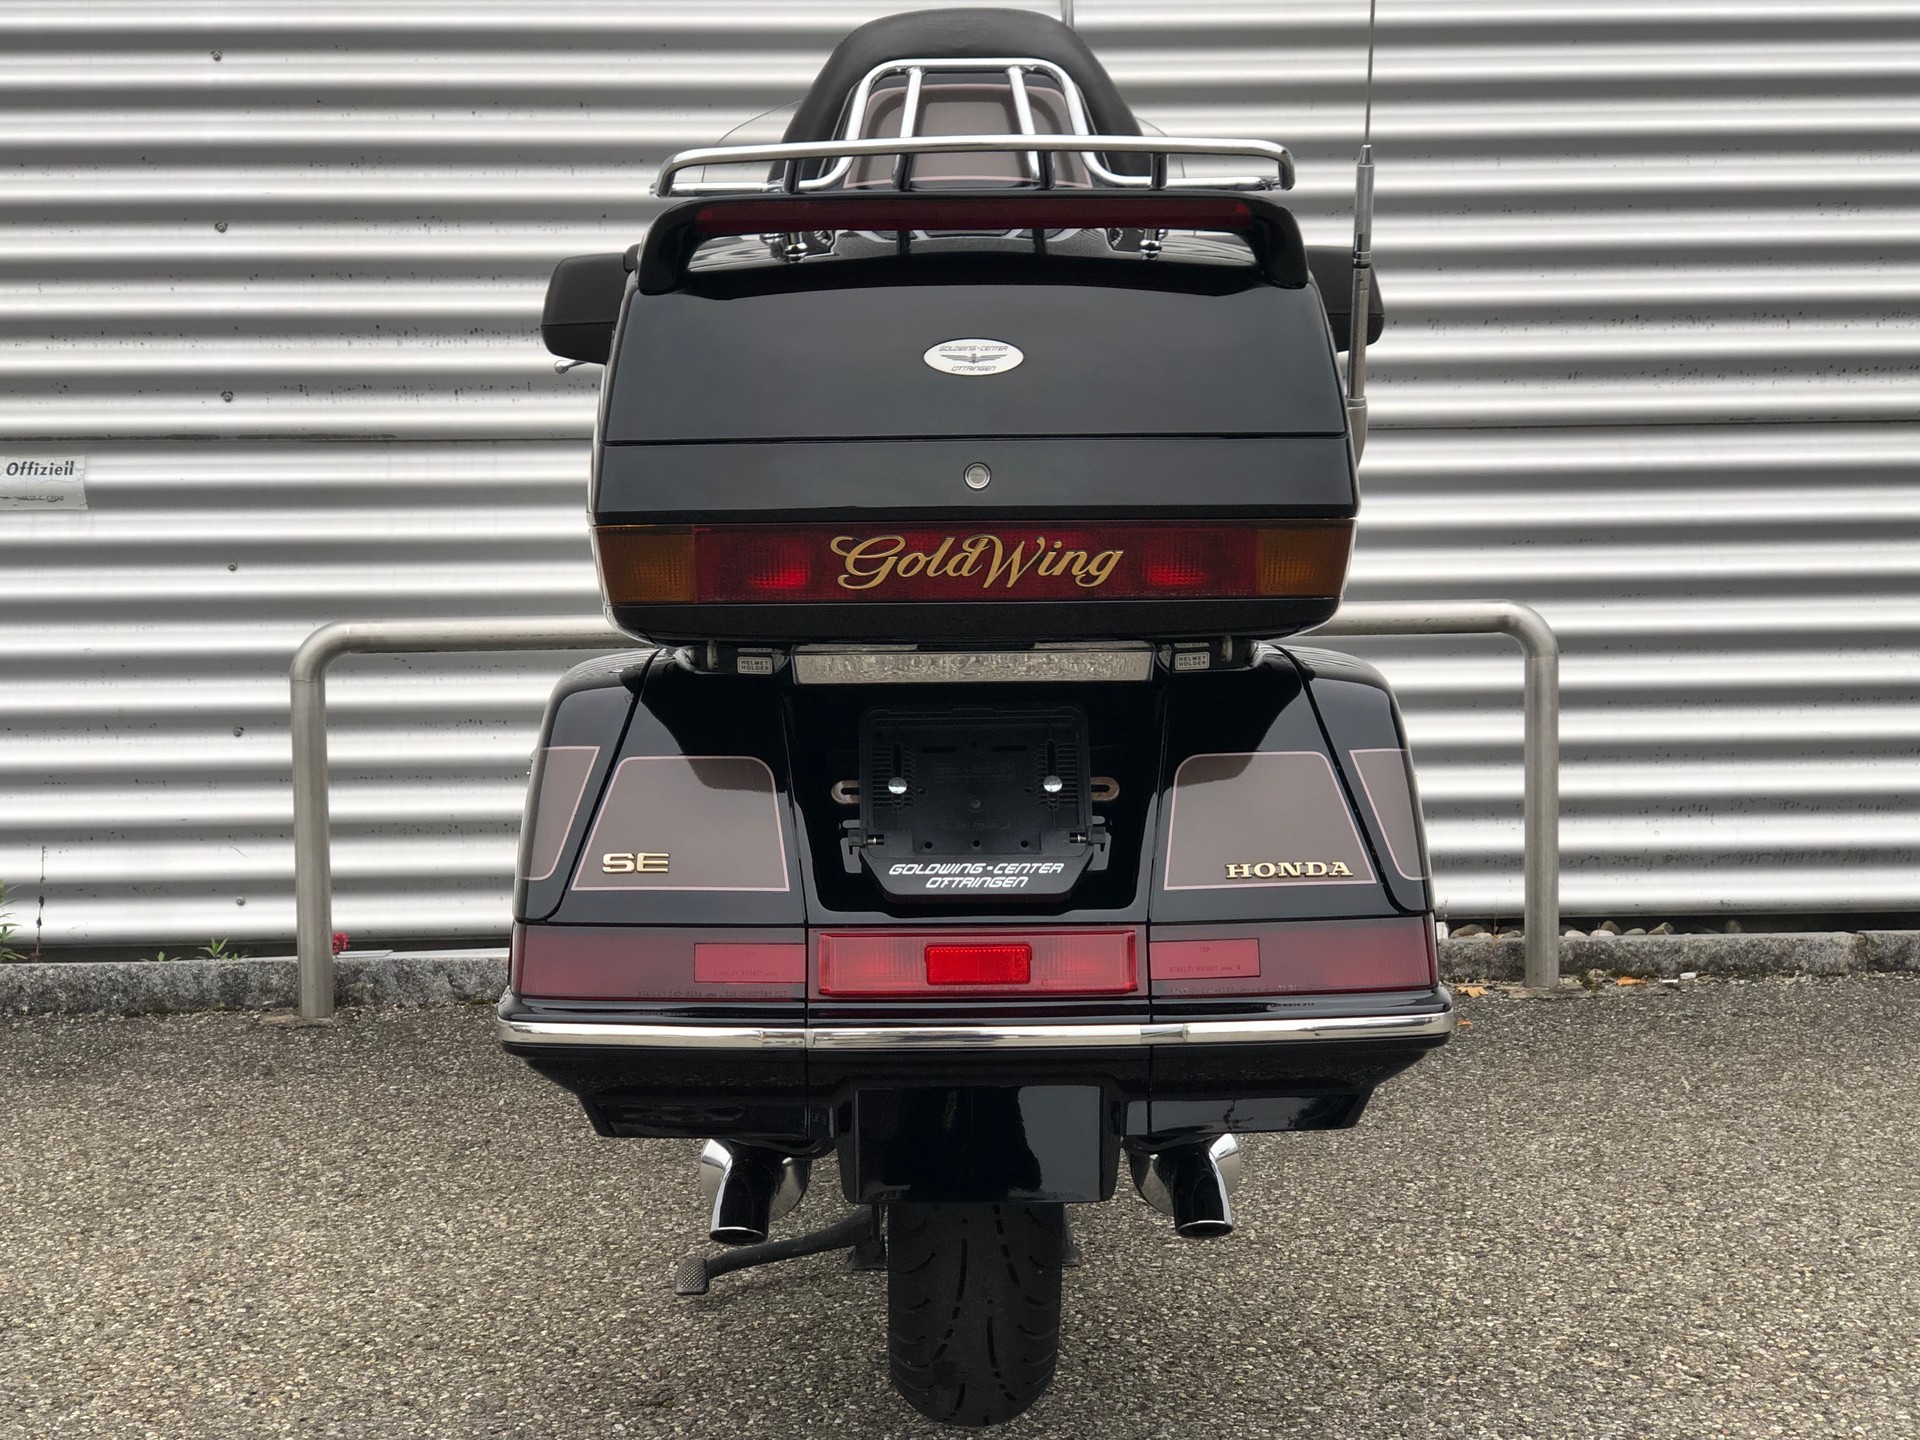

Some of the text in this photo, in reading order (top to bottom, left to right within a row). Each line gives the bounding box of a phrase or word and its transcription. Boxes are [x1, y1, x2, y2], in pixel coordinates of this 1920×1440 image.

[602, 852, 669, 873] SE
[1226, 861, 1354, 878] HONDA
[925, 876, 1029, 888] OFTRINGEN
